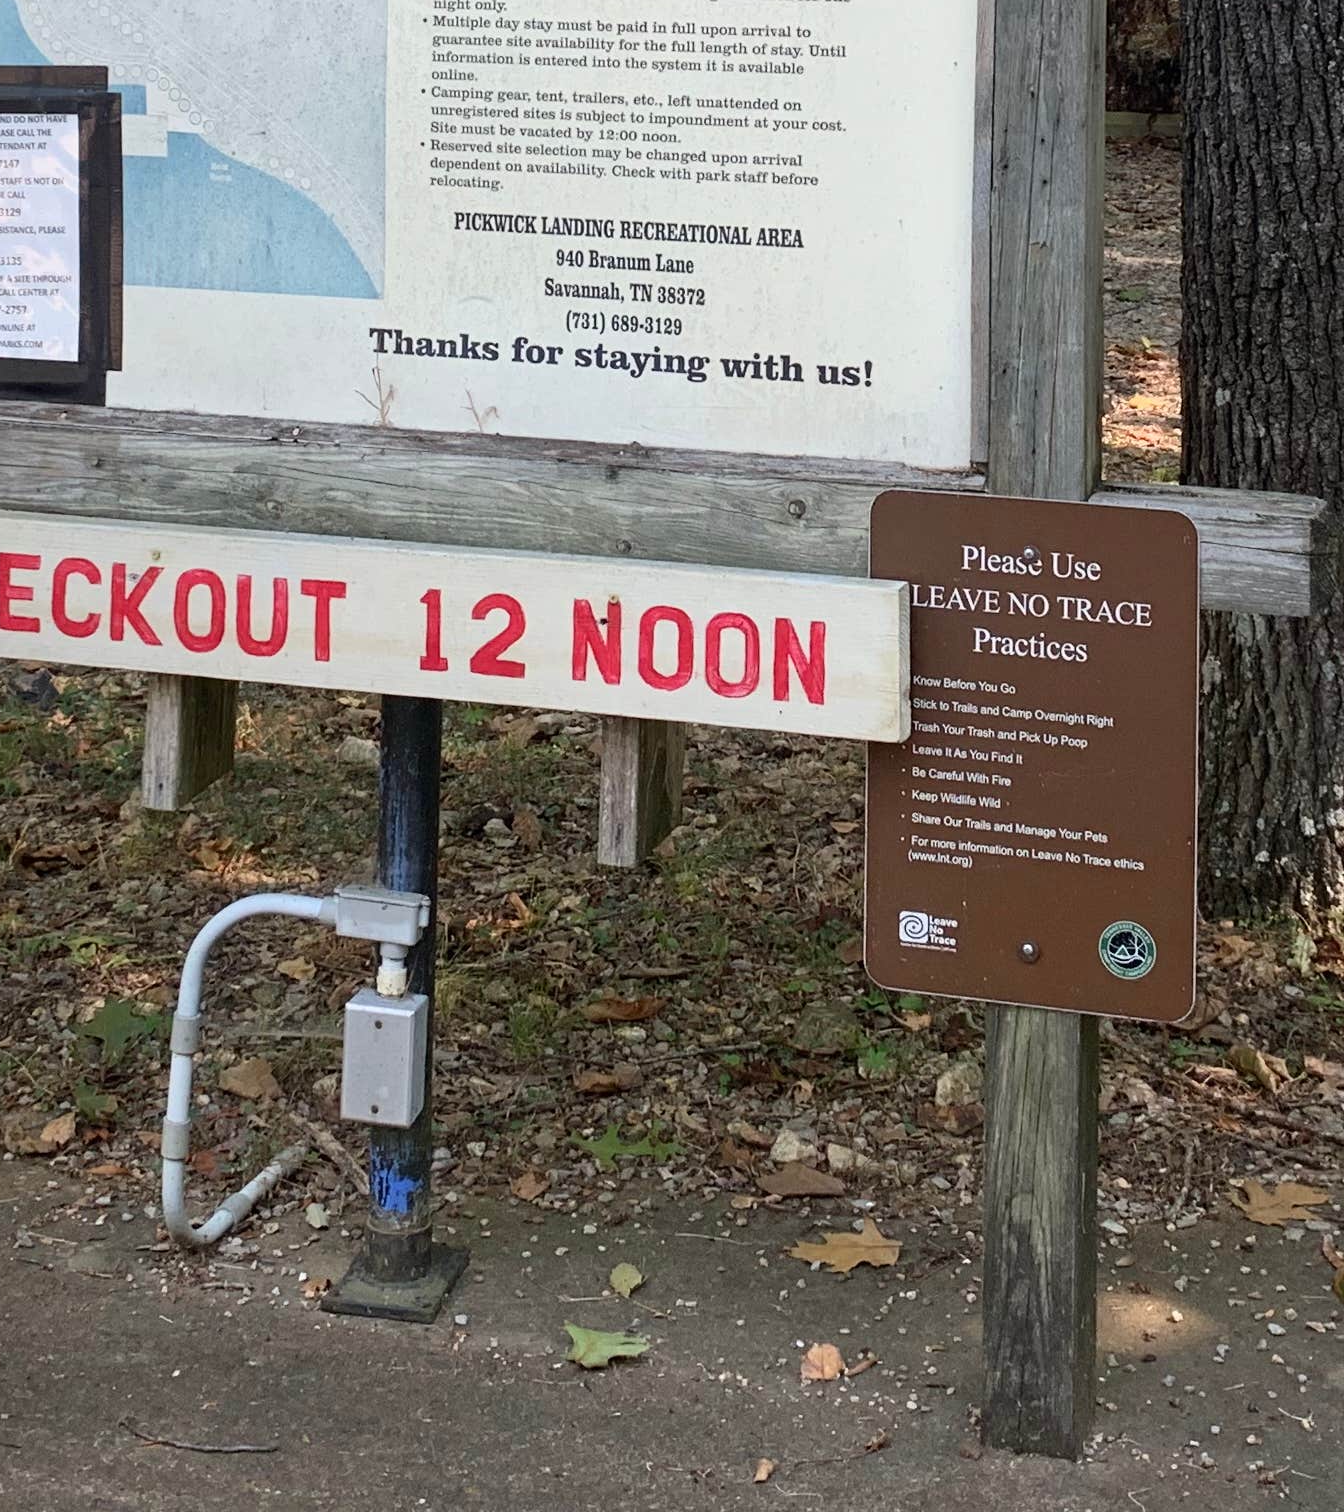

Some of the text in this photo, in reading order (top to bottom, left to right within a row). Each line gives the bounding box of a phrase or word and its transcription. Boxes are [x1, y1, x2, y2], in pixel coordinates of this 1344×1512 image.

[430, 121, 681, 143] Site must be vacated by 12:00 noon.
[454, 212, 804, 248] PICKWICK LANDING RECREATIONAL AREA
[556, 249, 694, 274] 940 Branum Lane
[544, 277, 705, 305] Savannah, TN 38372
[566, 310, 682, 335] (731) 689-3129
[368, 328, 872, 387] Thanks for staying with us!
[960, 545, 1101, 580] Please Use
[912, 584, 1152, 626] LEAVE NO TRACE
[418, 587, 526, 680] 12
[571, 599, 826, 705] NOON
[972, 627, 1087, 661] Practices
[912, 675, 1016, 694] Know Before You Go
[912, 697, 1114, 728] Stick to Trails and Camp Overnight Right
[912, 720, 1088, 749] Trash Your Trash and Pick Up Poop
[912, 744, 1023, 764] Leave It As You Find It
[911, 766, 1011, 786] Be Careful With Fire
[911, 789, 1001, 808] Keep Wildlife Wild
[911, 812, 1108, 843] Share Our Trails and Manage Your Pets
[910, 834, 1144, 870] For more information on Leave No Trace ethics
[929, 915, 958, 928] Leave
[929, 925, 944, 935] No
[929, 934, 957, 946] Trace
